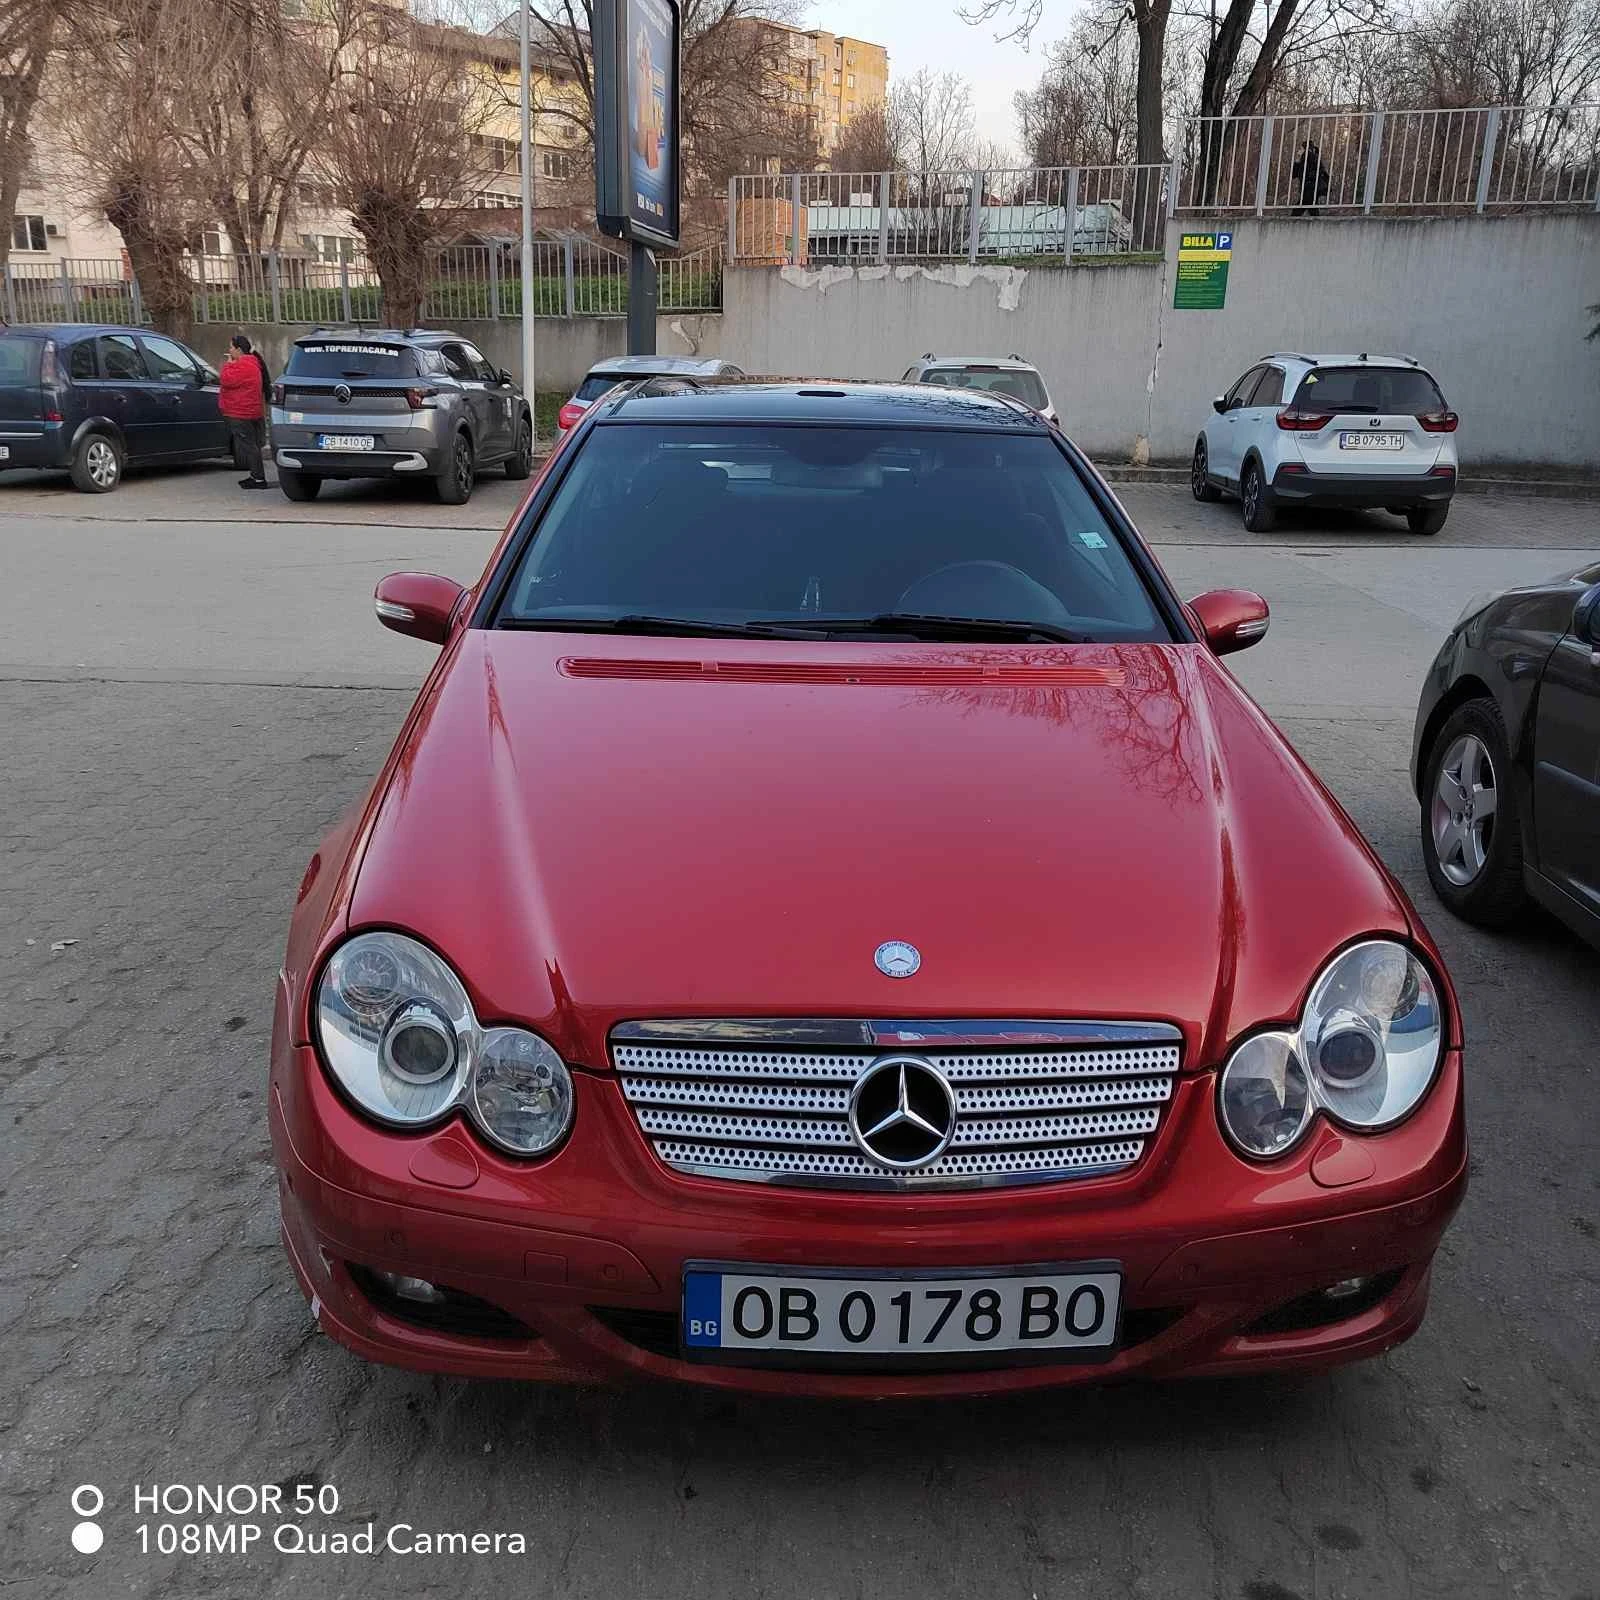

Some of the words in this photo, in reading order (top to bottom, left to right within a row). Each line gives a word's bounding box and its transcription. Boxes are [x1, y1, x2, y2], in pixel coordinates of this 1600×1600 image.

[1183, 236, 1213, 247] BILLA
[1219, 235, 1230, 248] P
[339, 437, 359, 447] 1410
[1347, 435, 1361, 446] CB
[1362, 435, 1387, 446] 0795
[1388, 435, 1402, 446] TH
[733, 1285, 820, 1341] OB
[838, 1288, 1002, 1344] 0178
[1018, 1283, 1105, 1340] BO
[690, 1319, 718, 1336] BG
